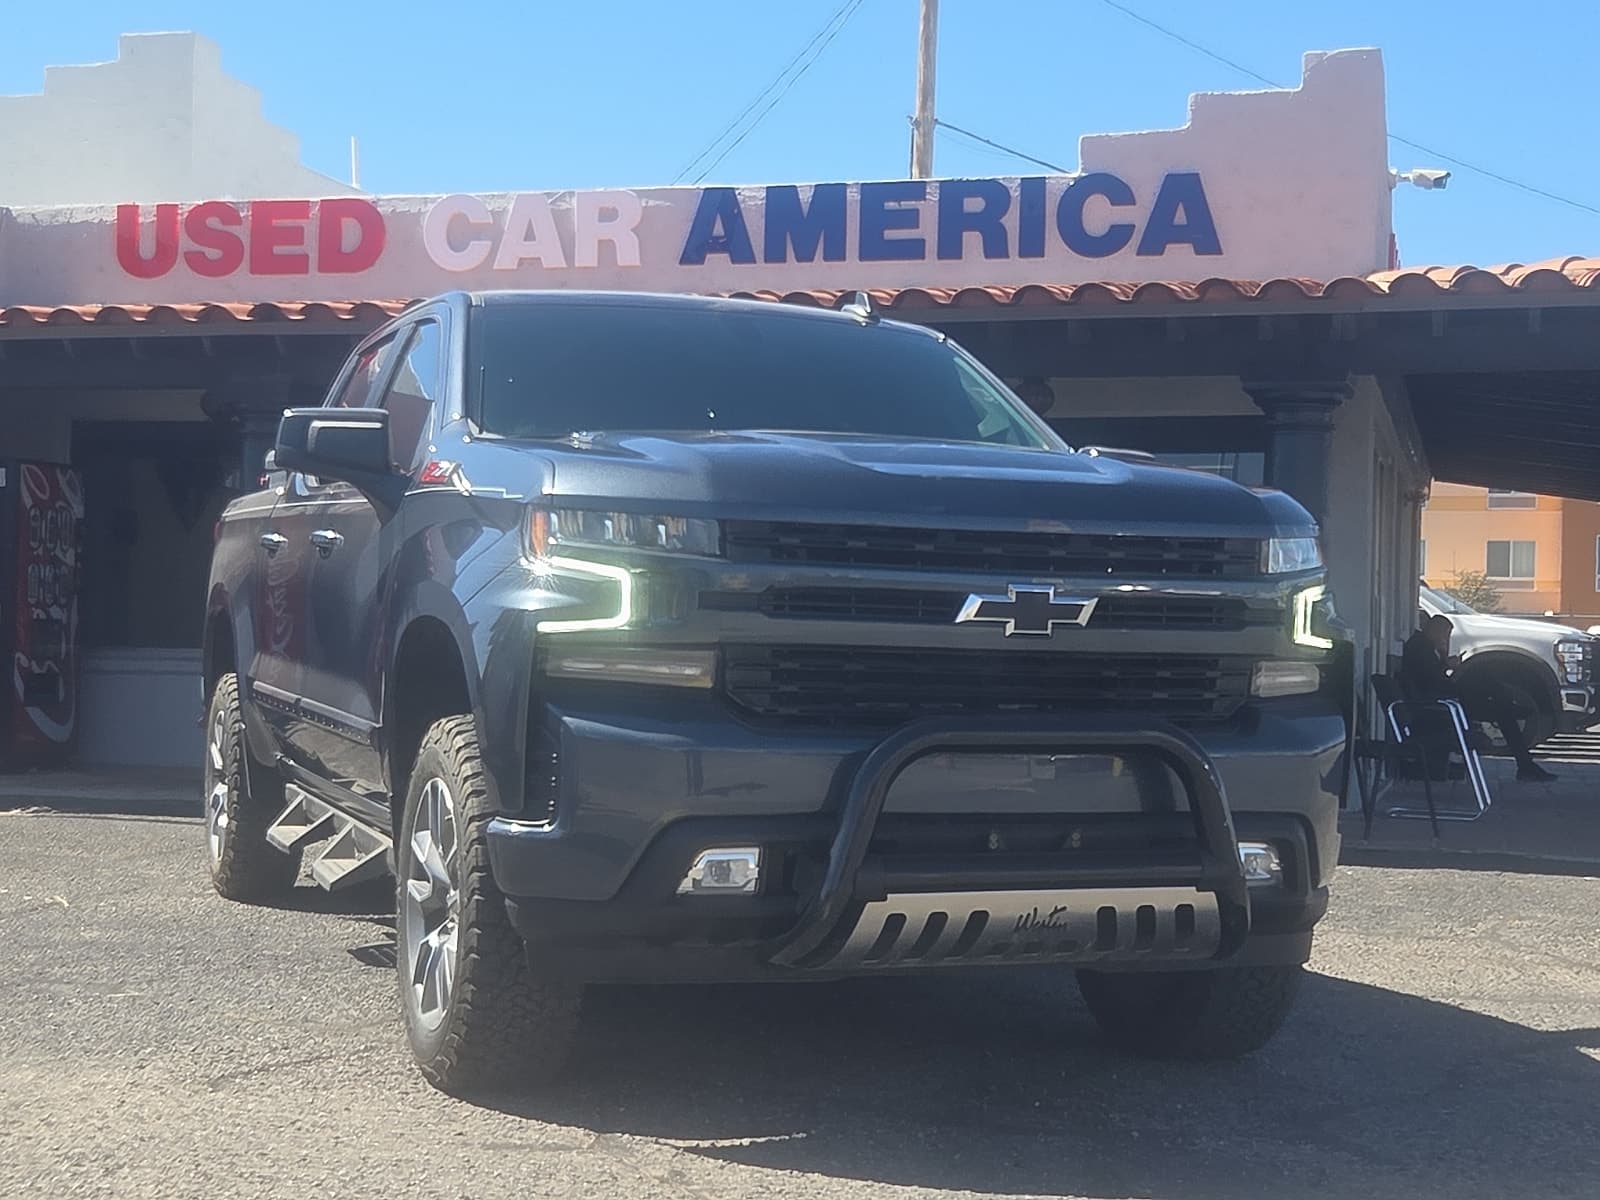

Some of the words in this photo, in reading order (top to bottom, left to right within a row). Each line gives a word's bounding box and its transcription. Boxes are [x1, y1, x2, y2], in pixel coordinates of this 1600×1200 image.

[115, 199, 386, 278] USED
[423, 190, 643, 271] CAR
[679, 172, 1223, 265] AMERICA
